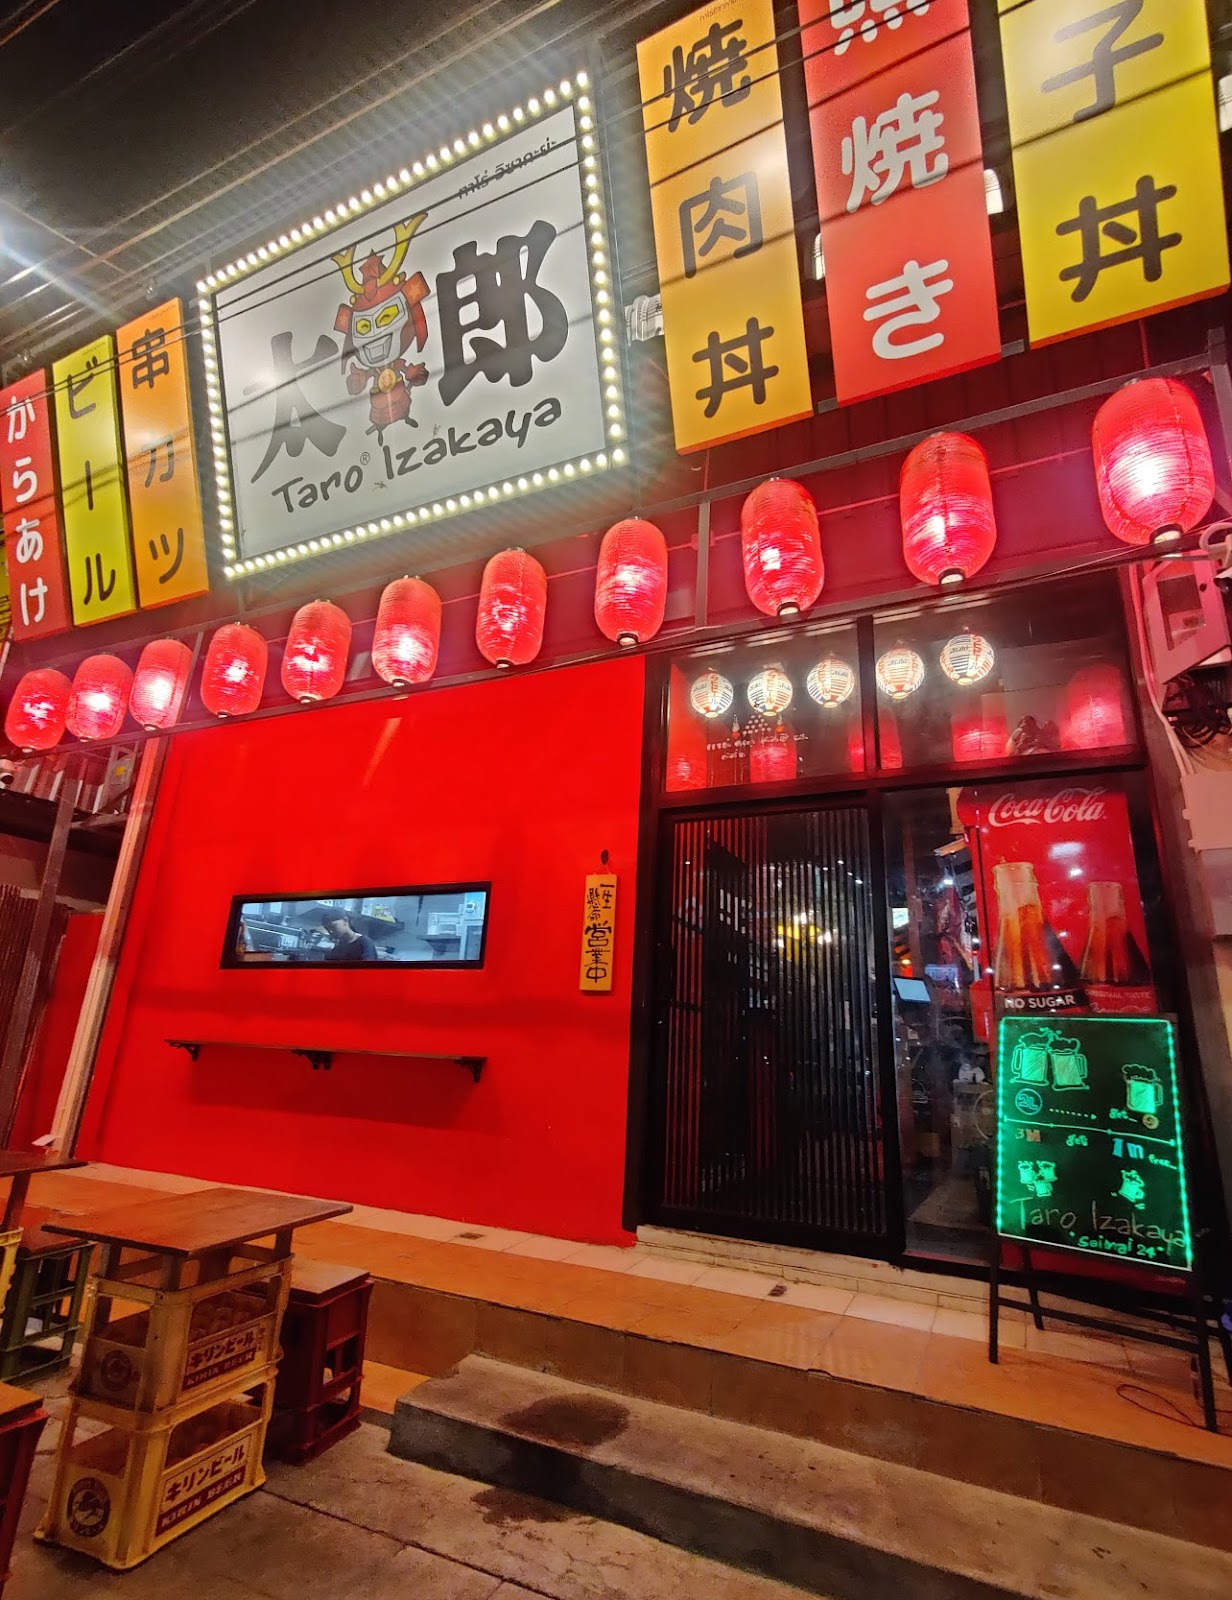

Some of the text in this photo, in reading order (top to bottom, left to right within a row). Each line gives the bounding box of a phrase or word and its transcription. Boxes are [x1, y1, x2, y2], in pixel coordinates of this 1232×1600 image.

[661, 18, 779, 419] 焼肉丼
[66, 356, 116, 606] ビール
[131, 328, 184, 585] 串カツ
[382, 397, 562, 482] Izakaya
[1004, 996, 1026, 1010] NO
[1028, 994, 1076, 1009] SUGAR
[1009, 1197, 1188, 1256] Taro Izakaya
[165, 1445, 245, 1502] キリンビール
